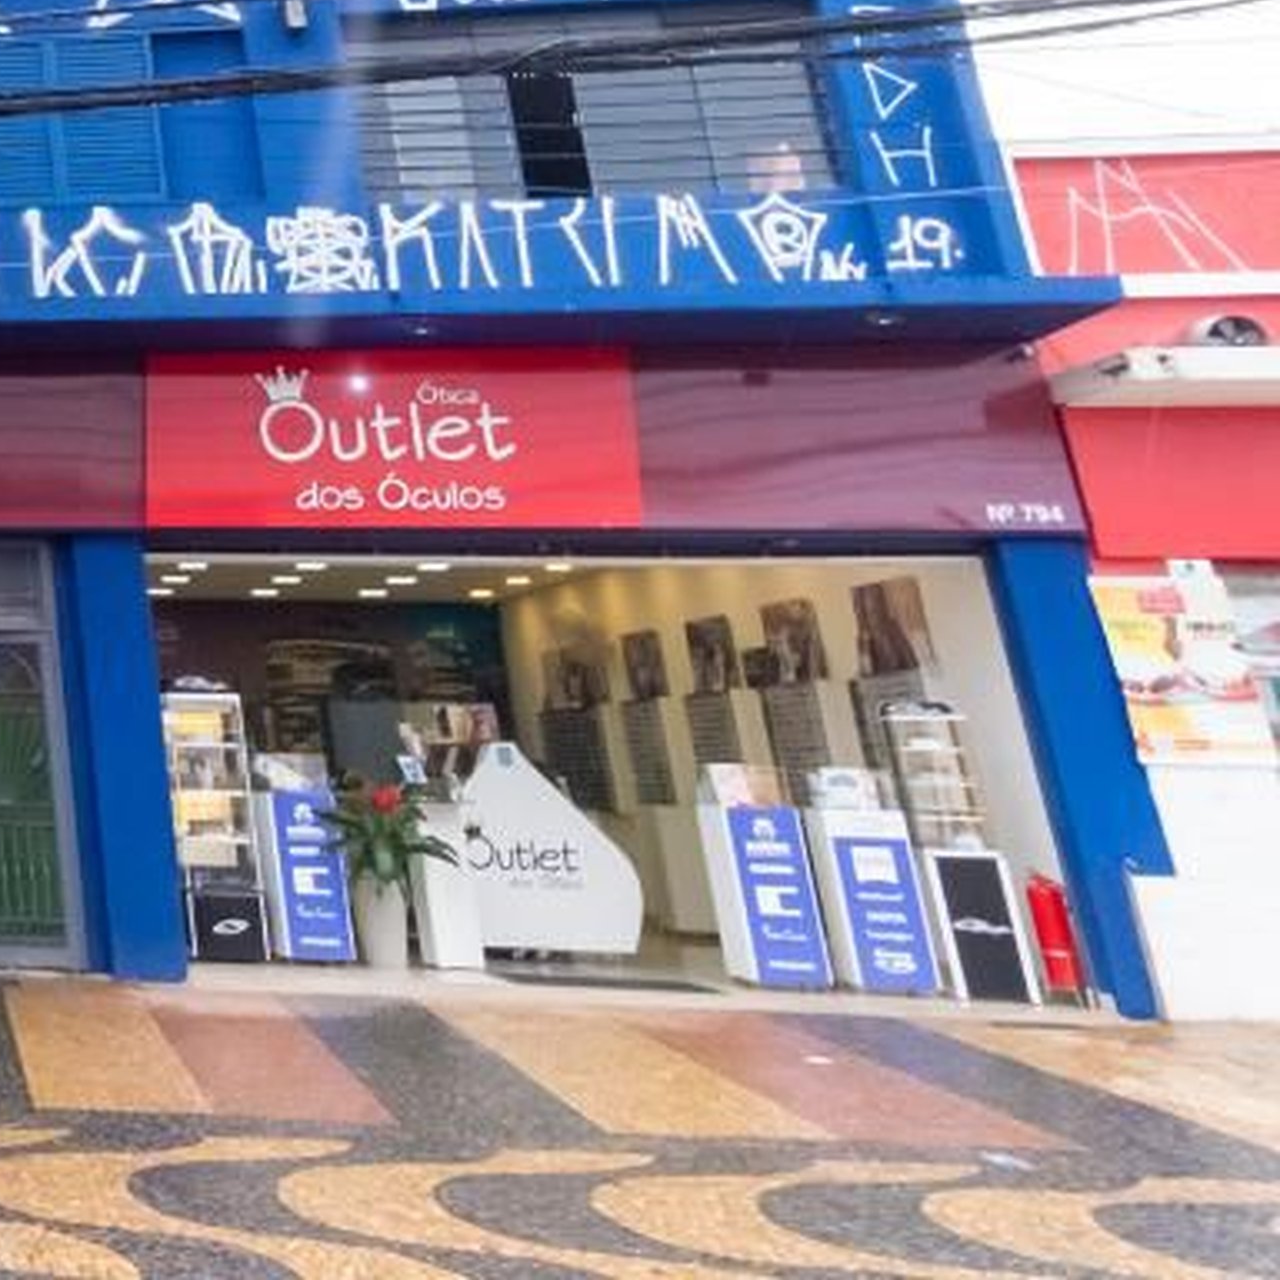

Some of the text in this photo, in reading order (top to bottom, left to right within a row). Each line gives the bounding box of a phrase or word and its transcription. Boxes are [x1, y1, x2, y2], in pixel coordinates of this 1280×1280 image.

[260, 400, 517, 462] Outlet
[296, 472, 506, 510] dos Óculos
[467, 832, 580, 871] Outlet
